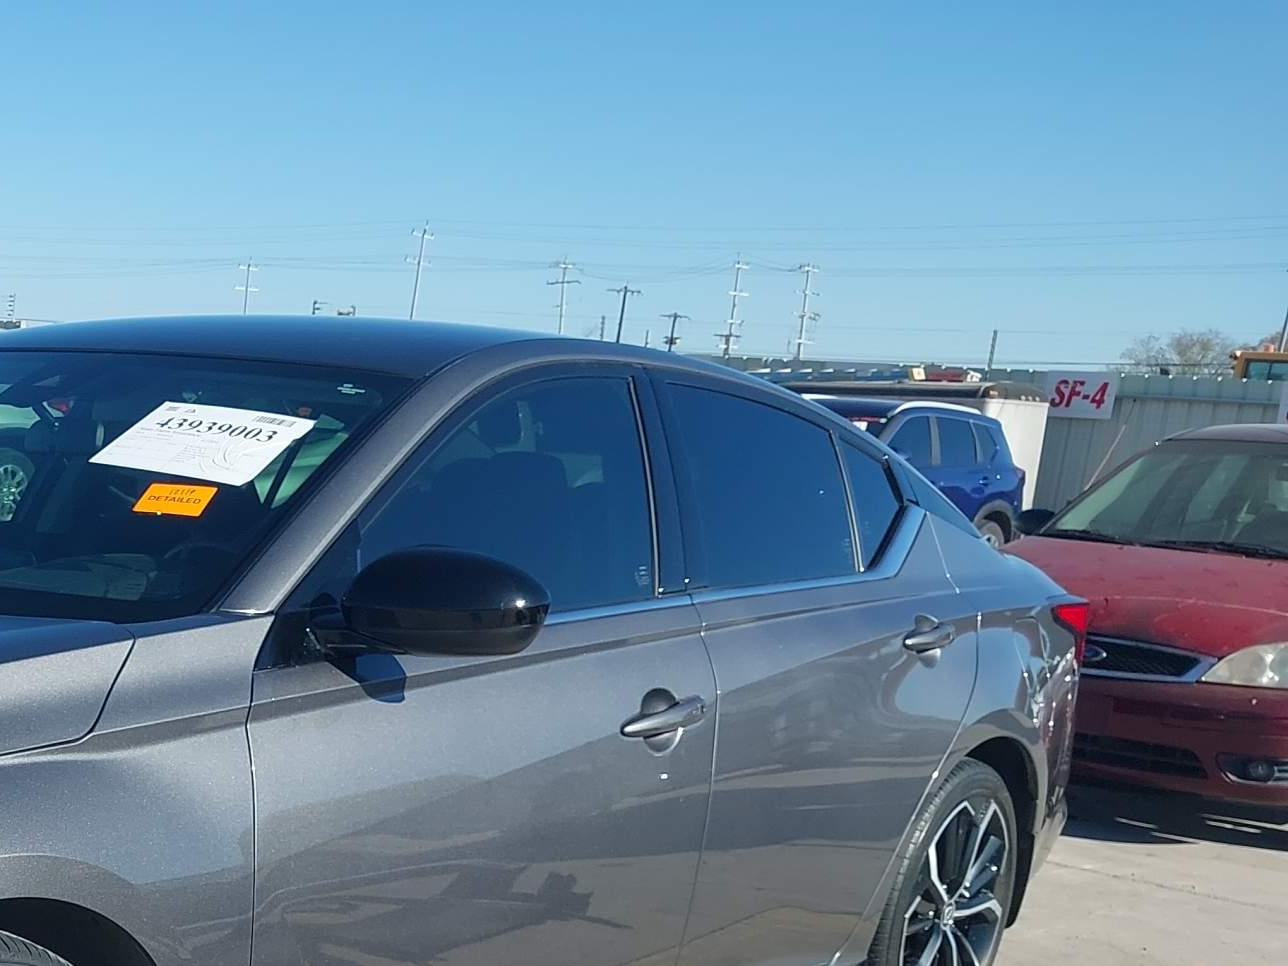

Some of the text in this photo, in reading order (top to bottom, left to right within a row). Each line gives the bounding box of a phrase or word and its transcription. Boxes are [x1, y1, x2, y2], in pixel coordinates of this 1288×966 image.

[1049, 379, 1110, 410] SF-4
[156, 416, 278, 443] 43939003
[147, 495, 201, 505] DETAILED
